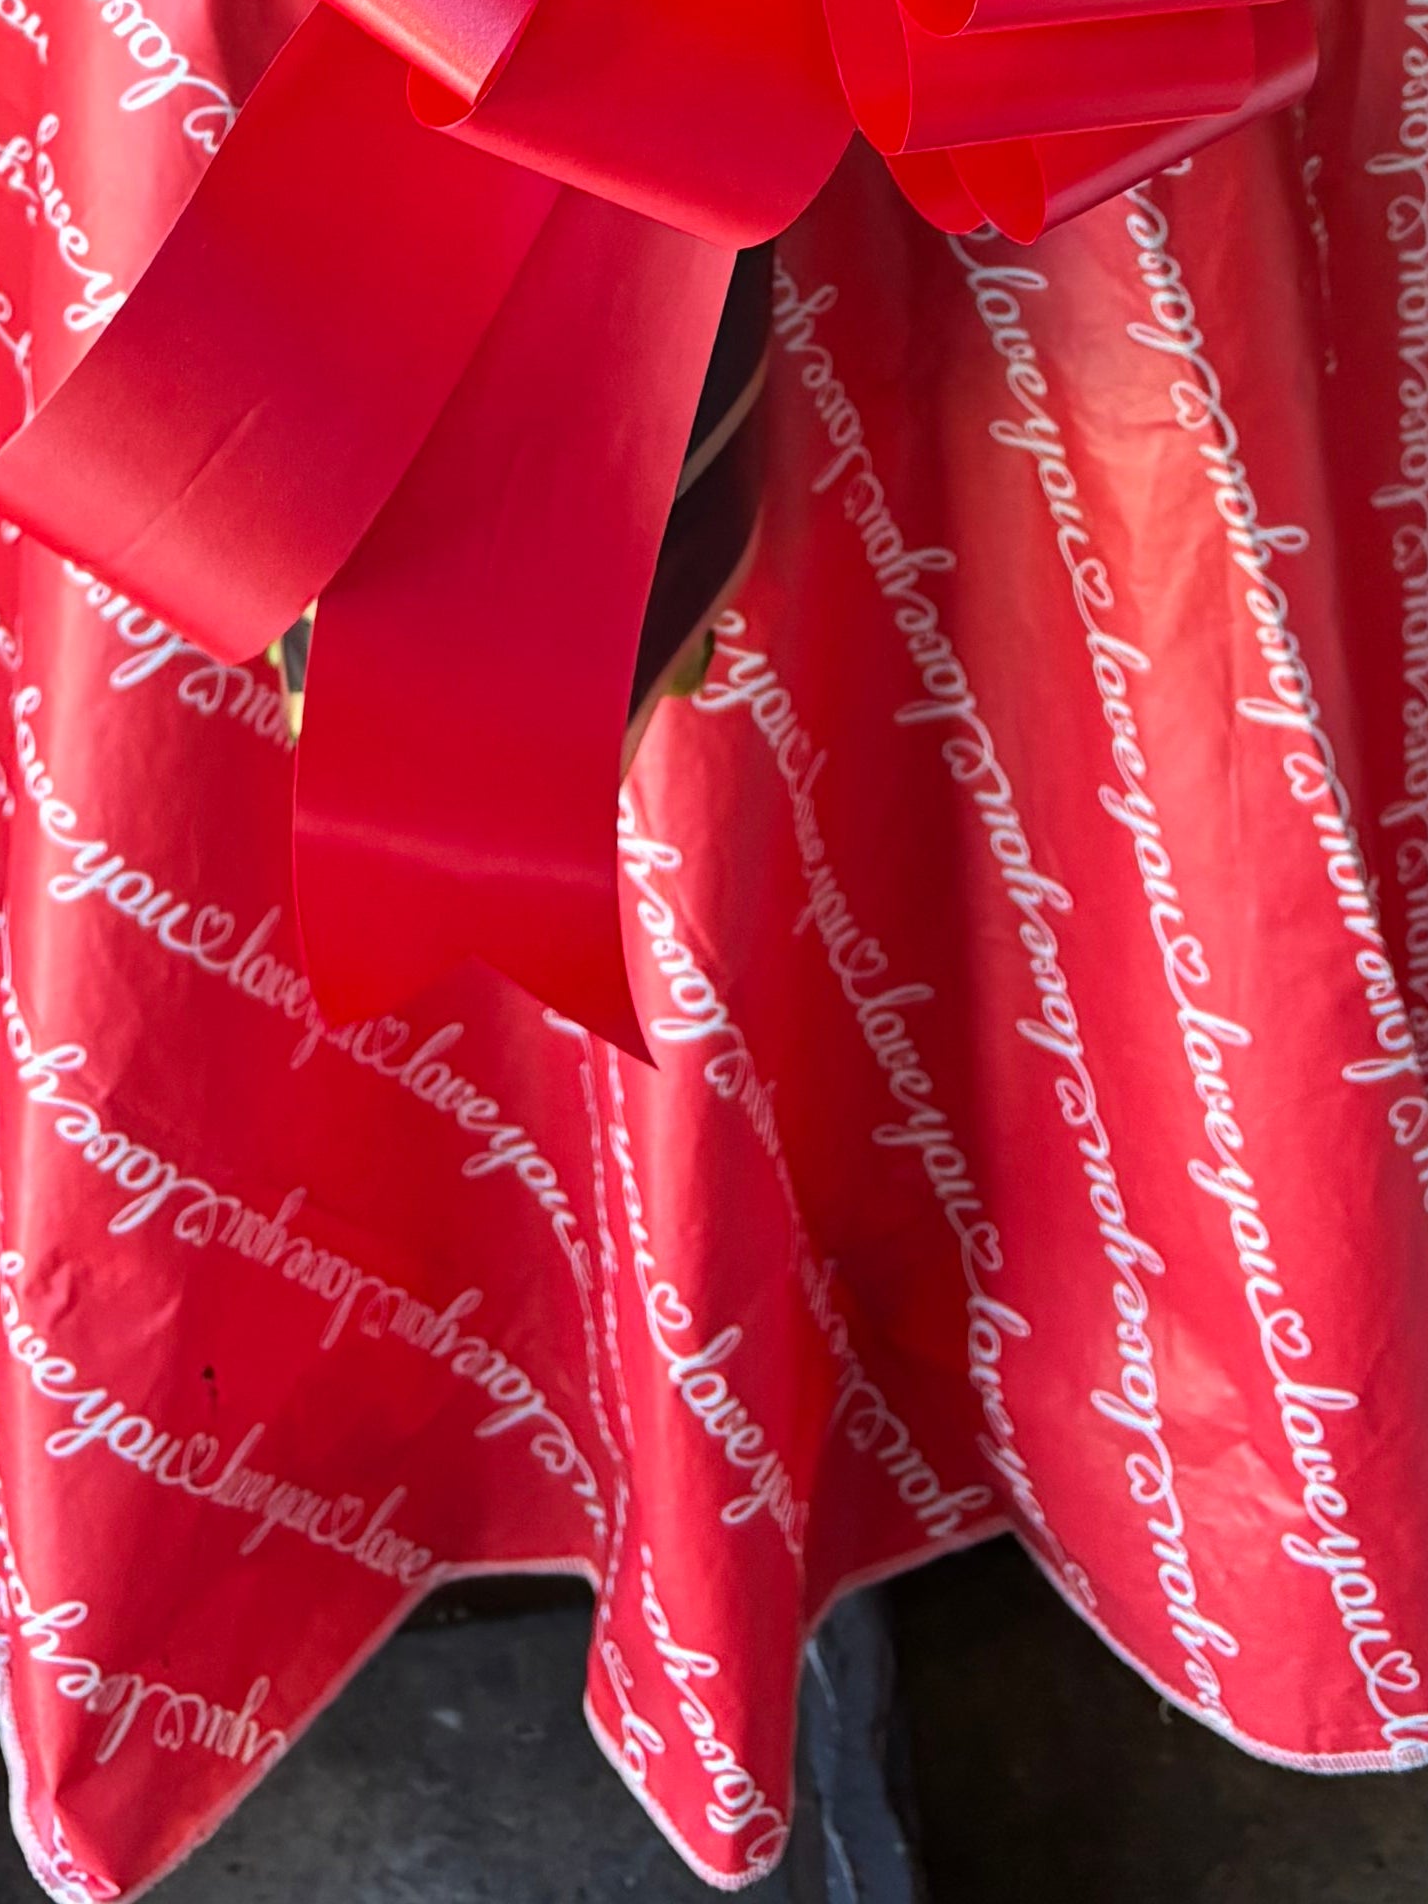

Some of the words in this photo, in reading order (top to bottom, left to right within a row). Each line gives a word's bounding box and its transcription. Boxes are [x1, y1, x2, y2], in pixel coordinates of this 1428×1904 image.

[966, 266, 1048, 404] love
[988, 412, 1086, 552] you
[1199, 435, 1310, 589] you
[894, 592, 977, 725] love
[1087, 628, 1152, 790] love
[1235, 585, 1321, 730] love
[974, 784, 1074, 912] you
[1099, 784, 1186, 929] you
[48, 840, 190, 944] you
[399, 1021, 500, 1132] love
[638, 894, 728, 1041] love
[1015, 914, 1085, 1059] love
[1176, 1001, 1253, 1156] love
[55, 1102, 178, 1235] love
[1078, 1136, 1167, 1276] you
[1186, 1158, 1285, 1297] you
[669, 1326, 765, 1469] love
[1091, 1279, 1163, 1432] love
[44, 1388, 186, 1483] you
[1274, 1382, 1360, 1529] love
[1148, 1516, 1241, 1658] you
[1281, 1532, 1393, 1648] you
